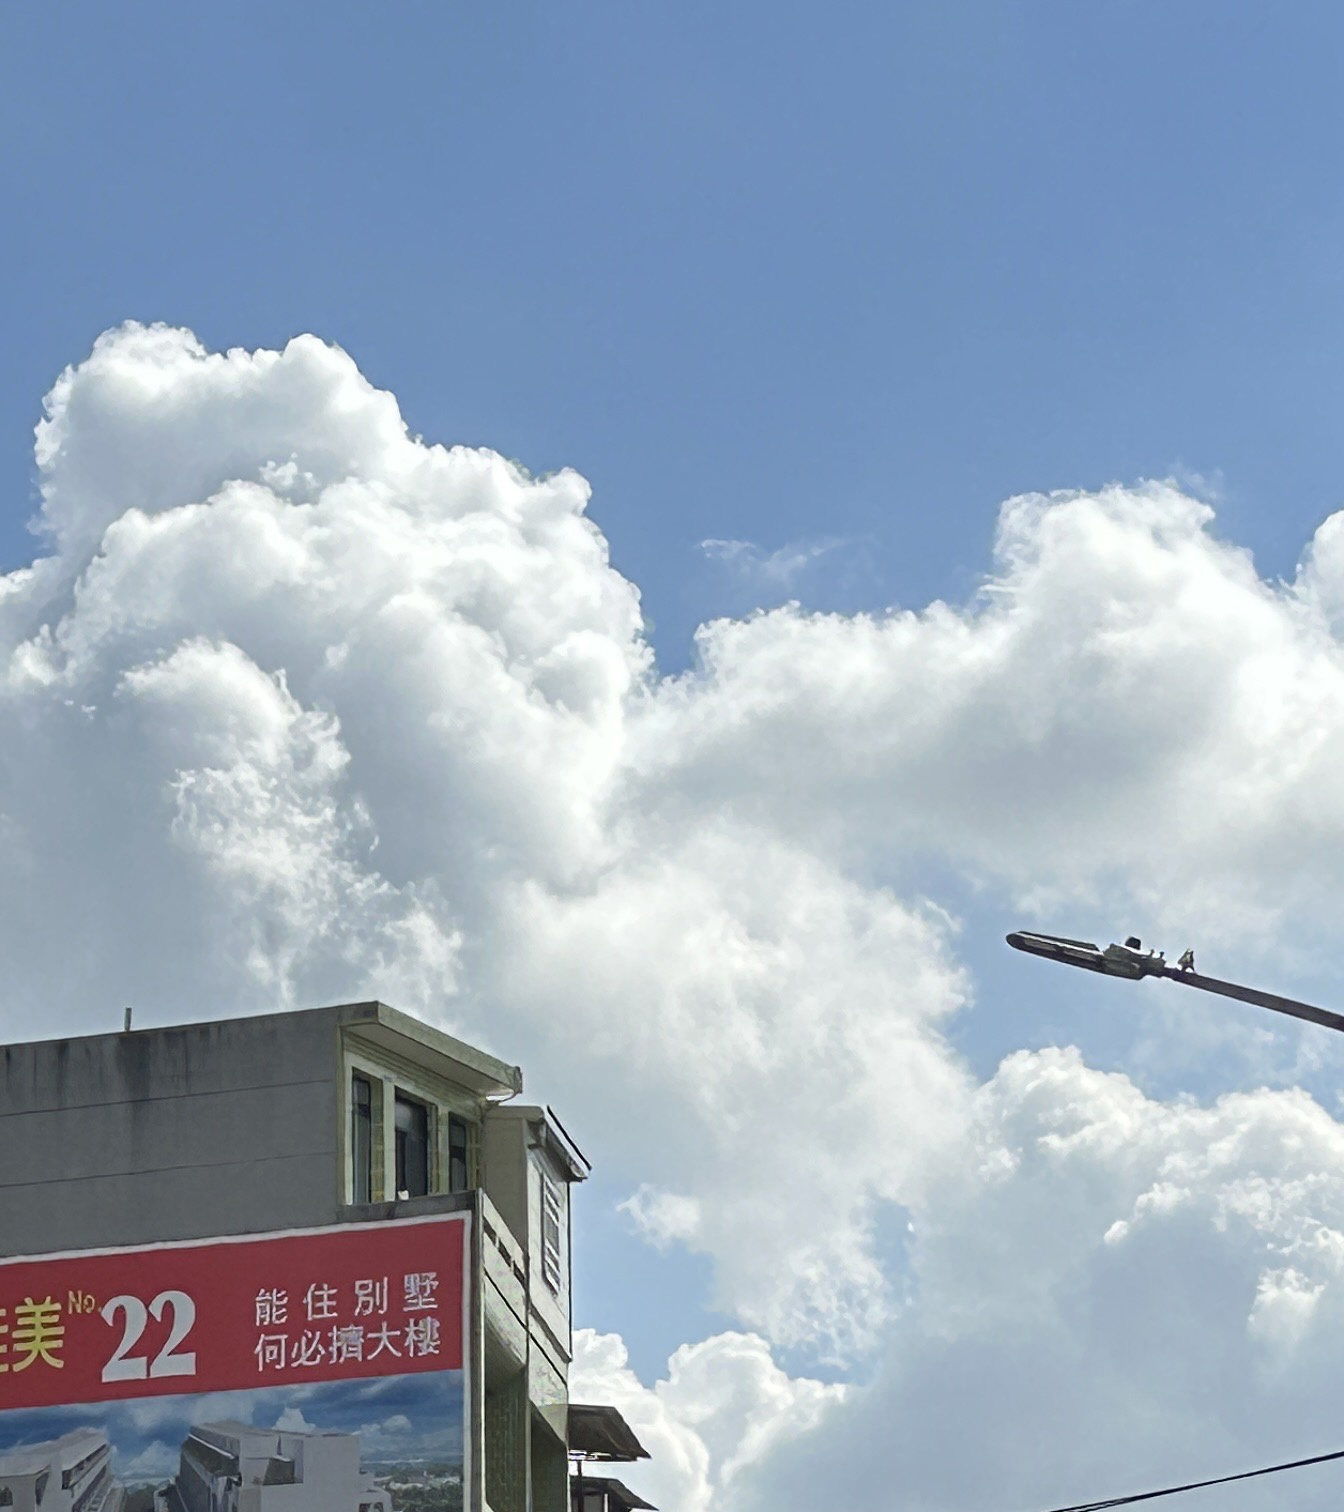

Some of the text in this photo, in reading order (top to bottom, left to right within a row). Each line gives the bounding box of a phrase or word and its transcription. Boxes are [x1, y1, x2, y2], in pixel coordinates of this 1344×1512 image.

[255, 1271, 439, 1327] 能住別墅
[101, 1290, 196, 1383] 22
[254, 1315, 441, 1372] 何必擠大樓
